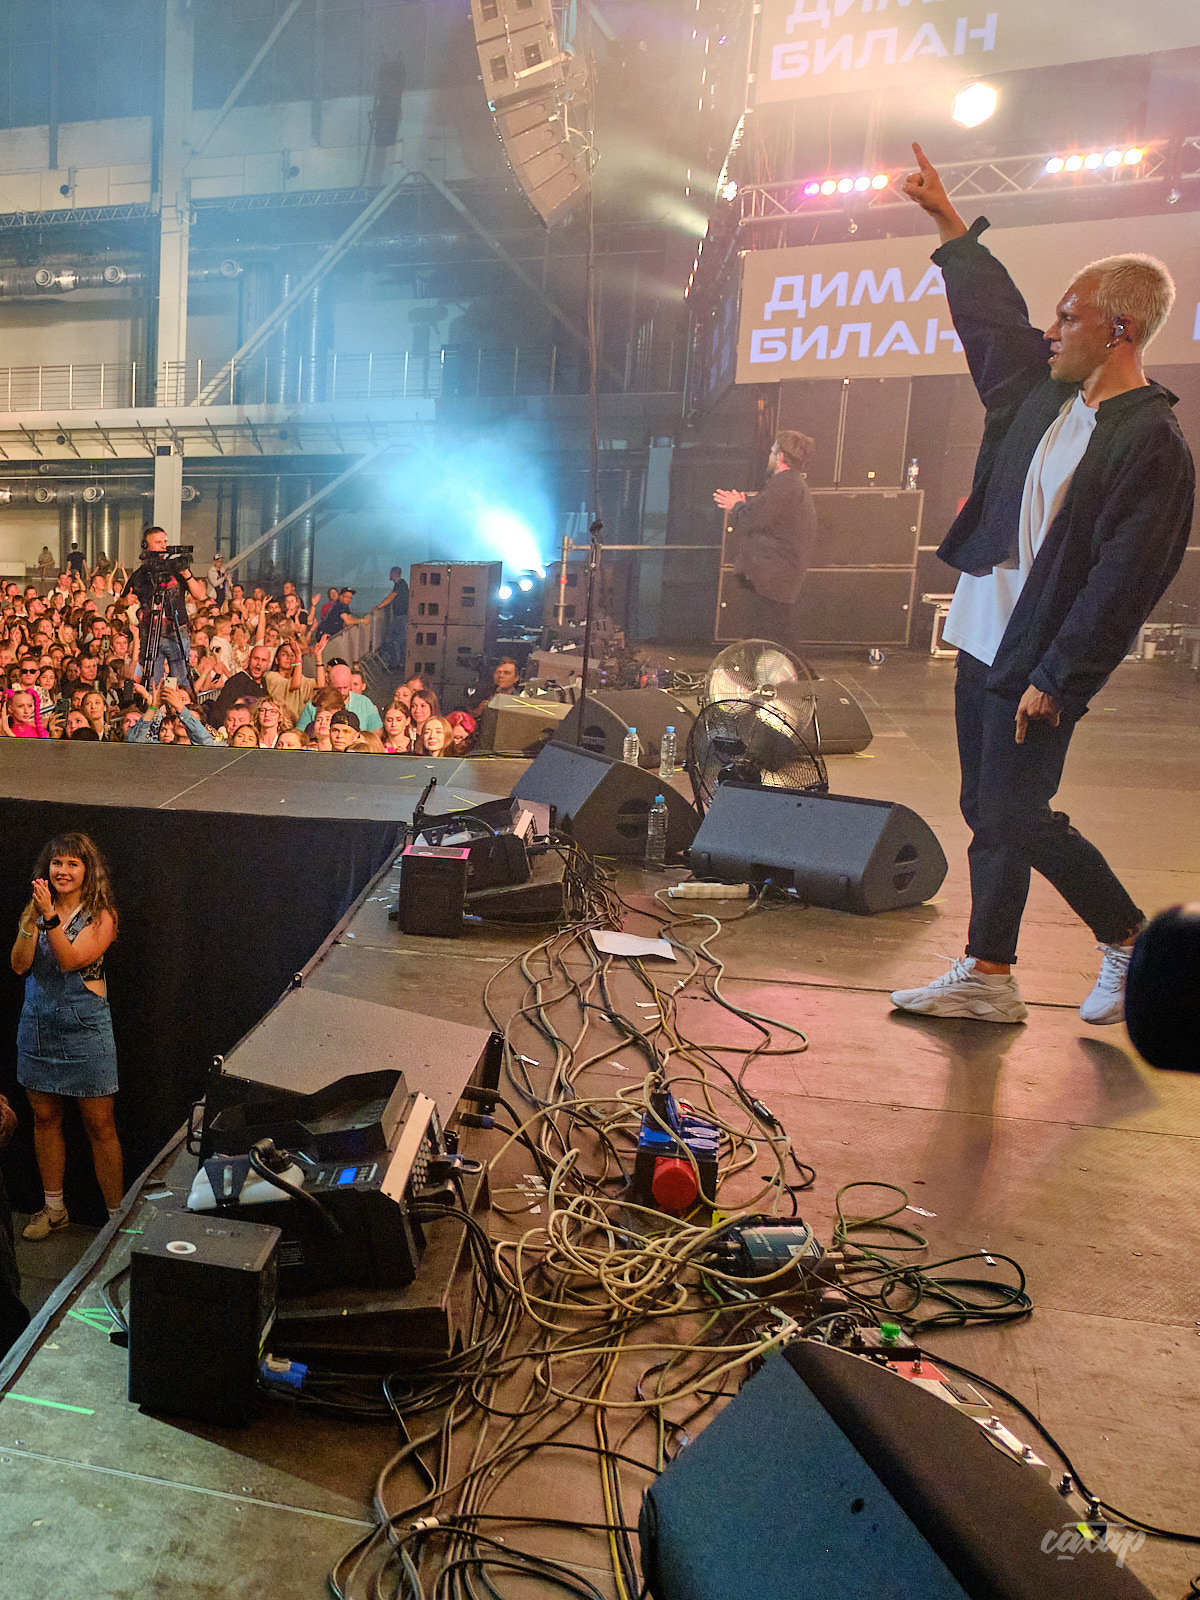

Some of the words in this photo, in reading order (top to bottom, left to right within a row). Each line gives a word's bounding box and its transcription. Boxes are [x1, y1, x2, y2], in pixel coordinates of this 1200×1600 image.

[770, 12, 998, 81] БИЛАН
[763, 264, 947, 321] ДИМА
[749, 318, 965, 364] БИЛАН
